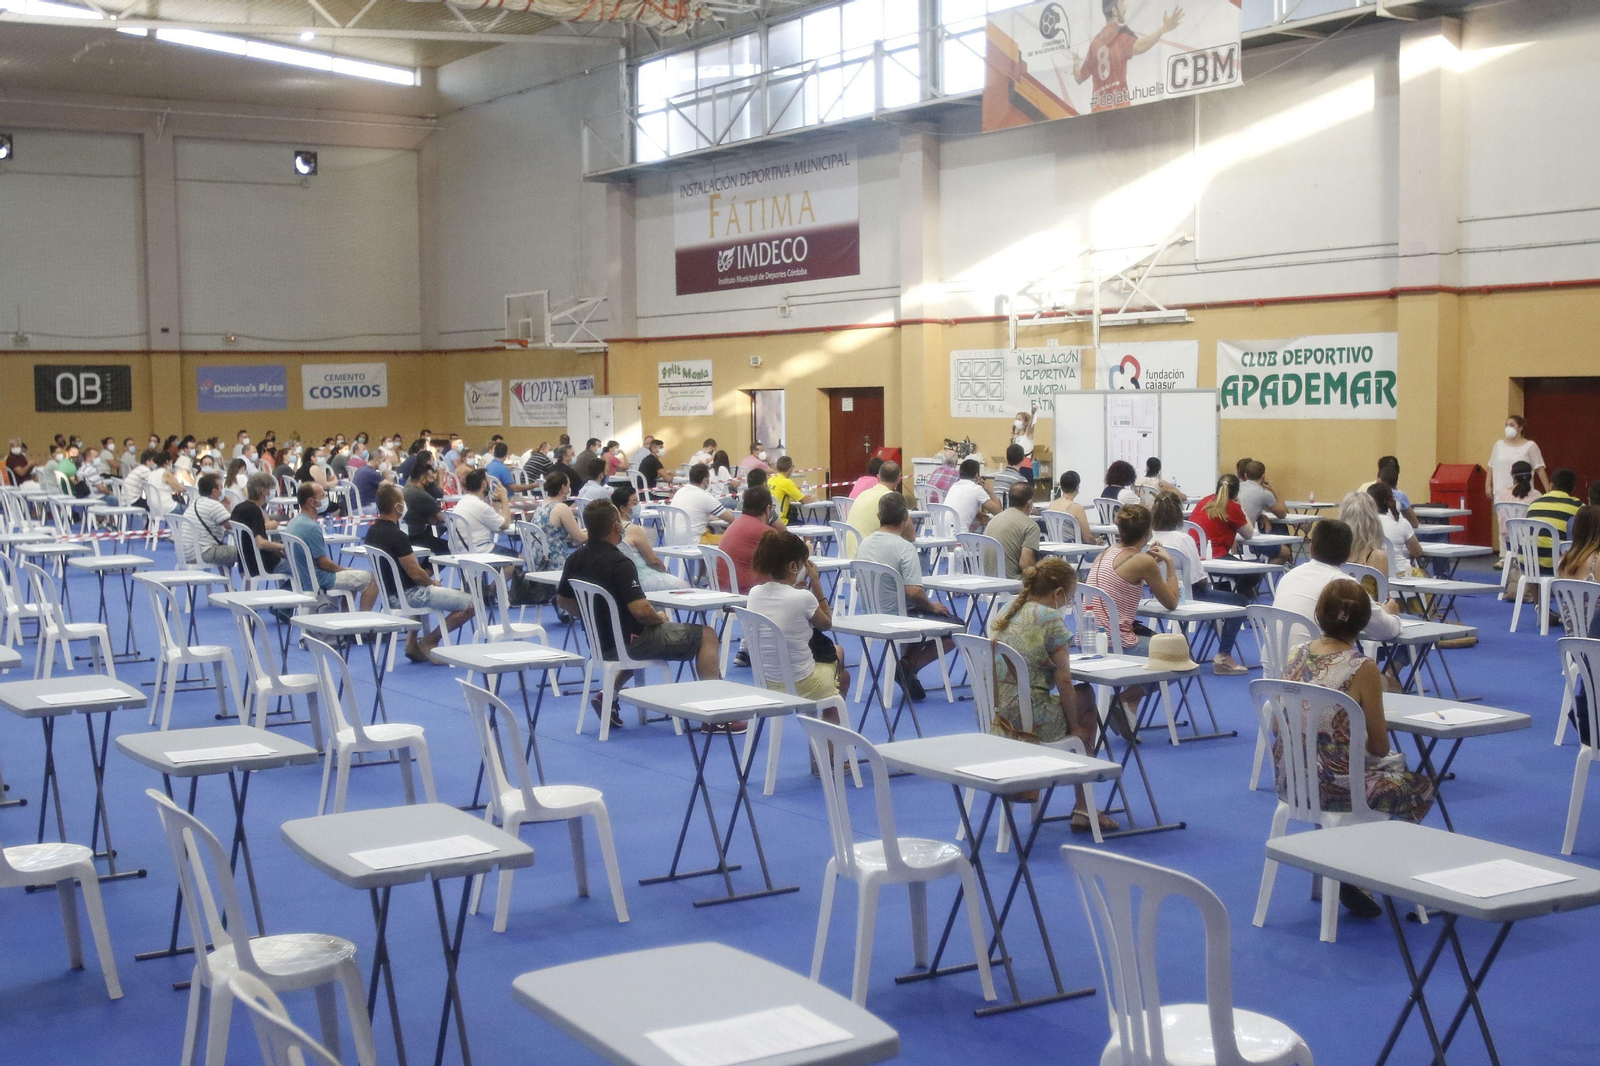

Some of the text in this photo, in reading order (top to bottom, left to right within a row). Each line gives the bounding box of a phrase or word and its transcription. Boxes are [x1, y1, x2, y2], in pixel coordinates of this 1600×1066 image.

[1170, 47, 1235, 90] CBM
[680, 151, 850, 198] INSTALACIÓN DEPORTIVA MUNICIPAL
[708, 190, 816, 238] FÁTIMA
[737, 236, 808, 270] IMDECO
[718, 268, 808, 285] Instituto Municipal de Deportes Córdoba
[1017, 350, 1079, 366] INSTALACIÓN
[1241, 346, 1374, 367] CLUB DEPORTIVO
[324, 374, 365, 382] CEMENTO
[1020, 366, 1076, 380] DEPORTIVA
[1146, 368, 1184, 380] fundación
[55, 372, 102, 406] OB
[213, 382, 284, 394] Domino's Pizza
[309, 384, 381, 399] COSMOS
[523, 380, 579, 403] COPYFAX
[1220, 369, 1398, 409] APADEMAR
[957, 402, 1005, 415] FÁTIMA
